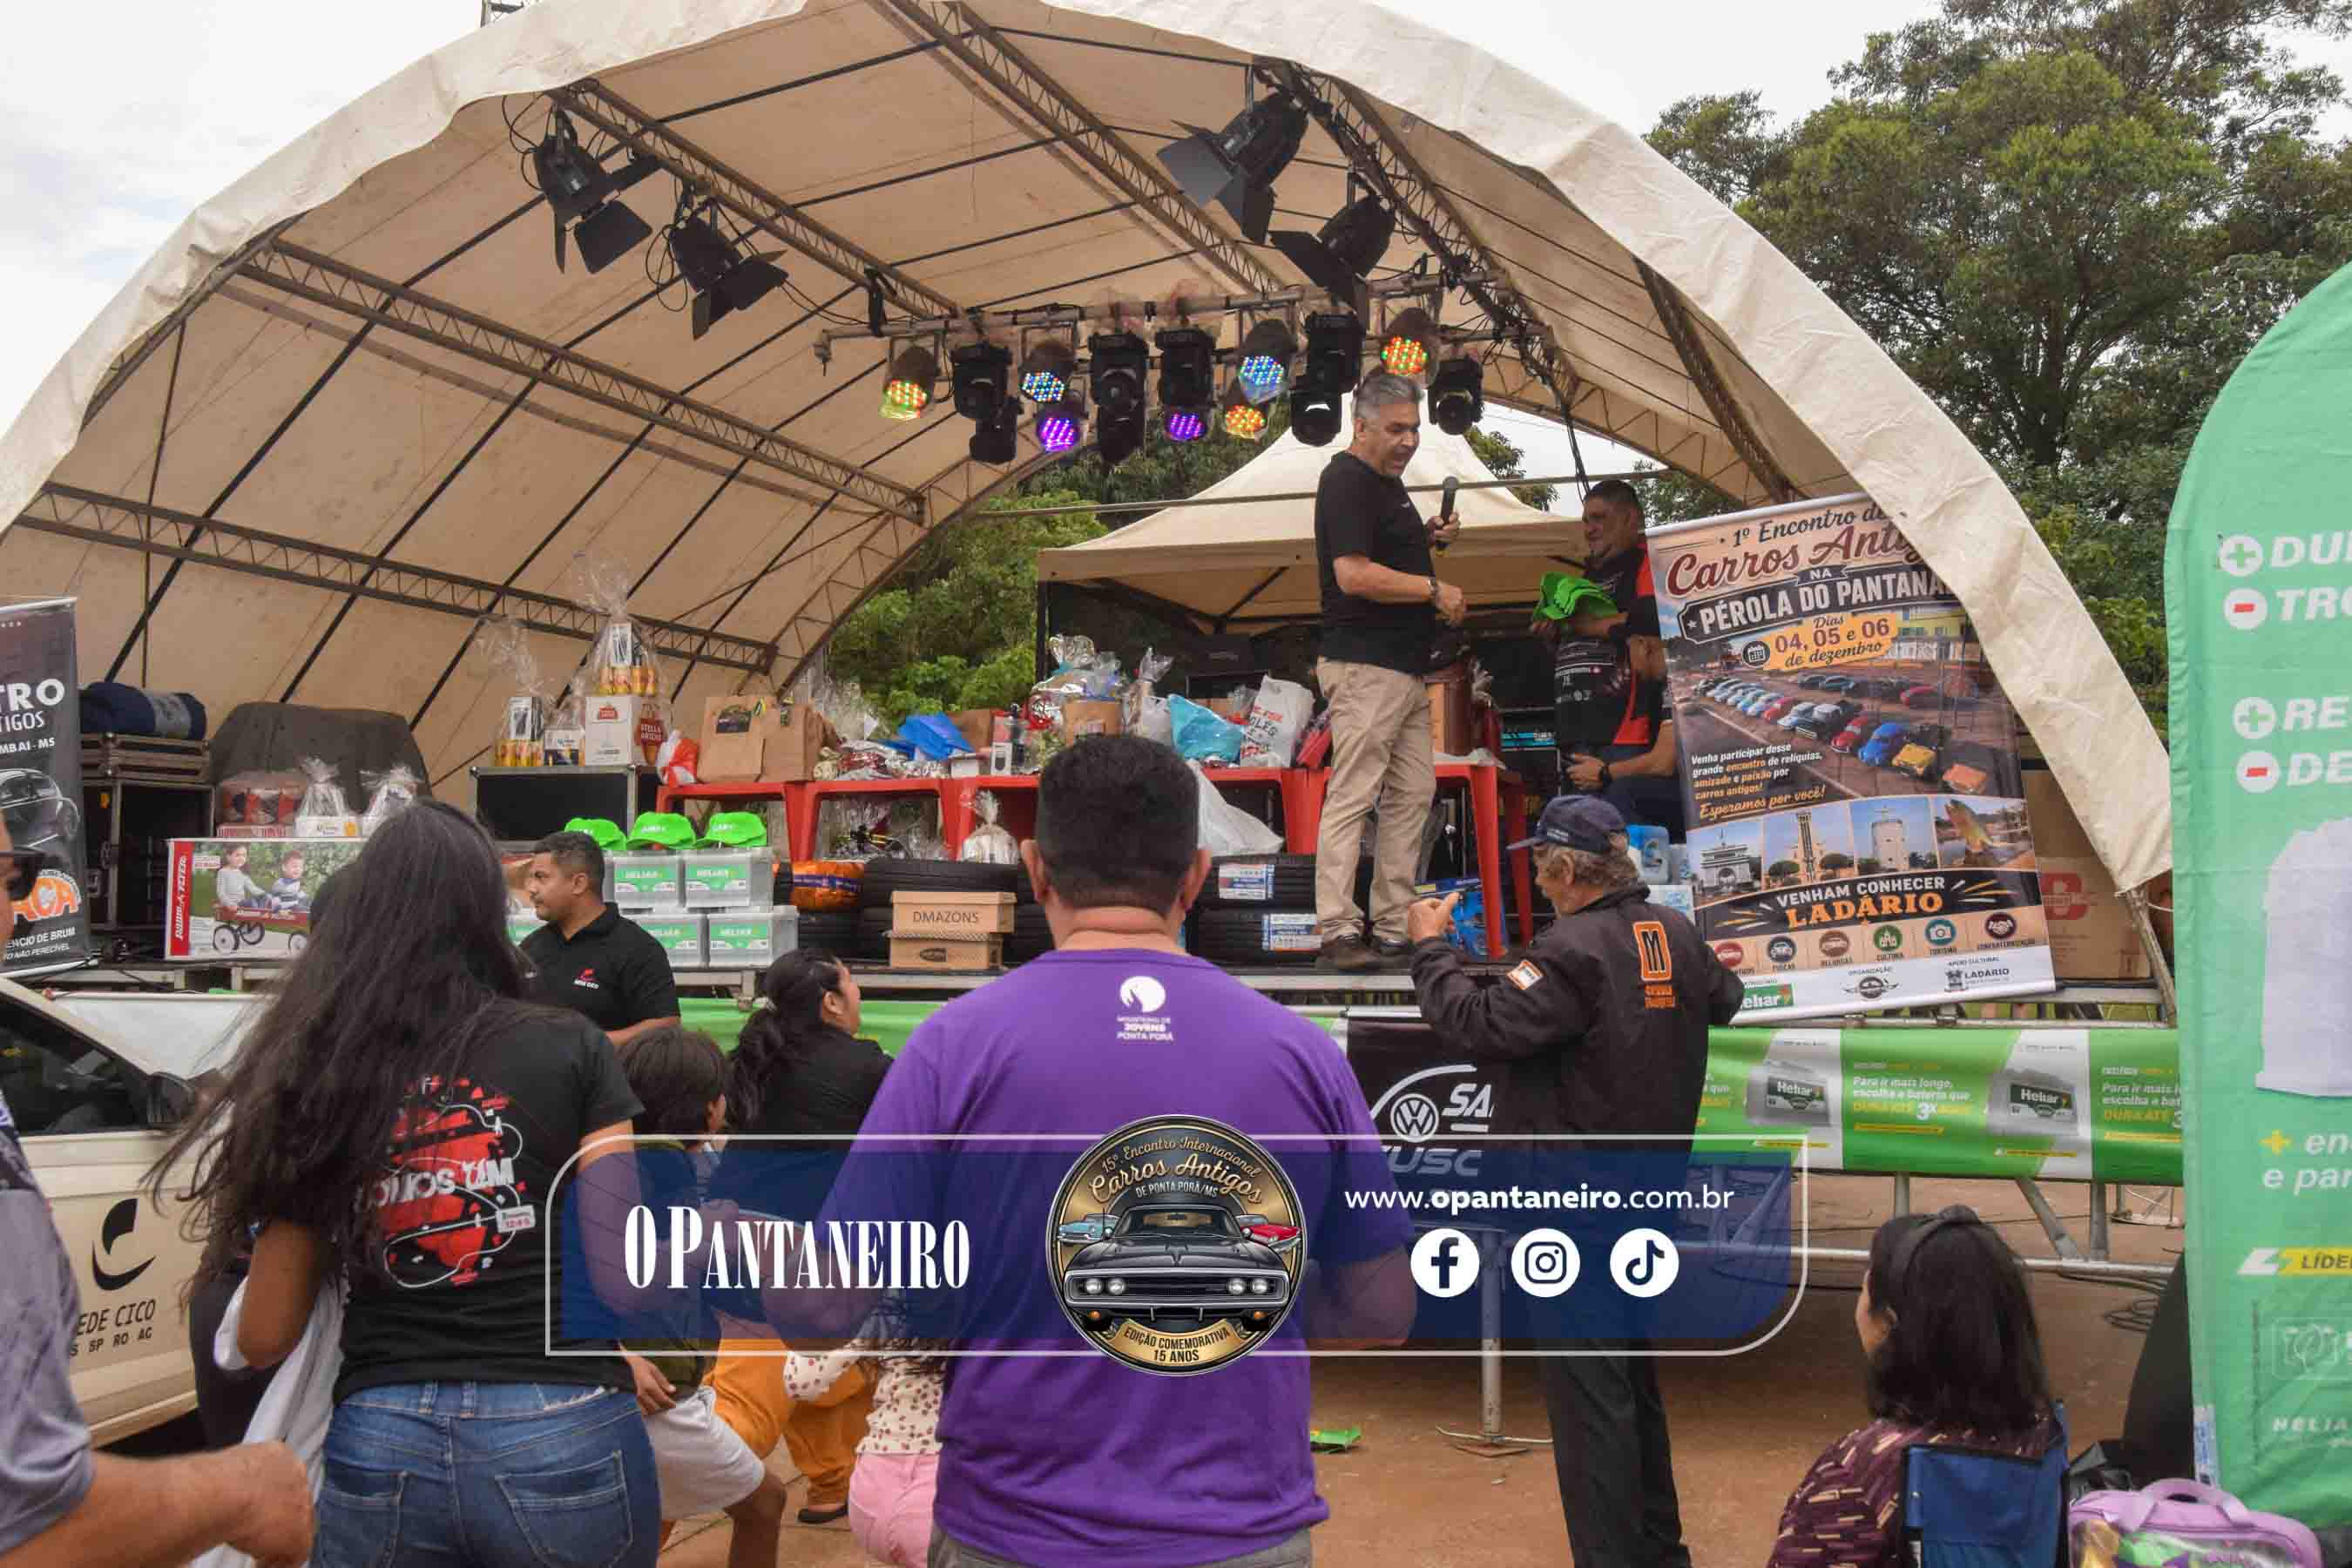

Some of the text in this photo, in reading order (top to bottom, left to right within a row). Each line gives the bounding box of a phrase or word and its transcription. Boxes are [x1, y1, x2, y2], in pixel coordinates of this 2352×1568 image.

[1758, 509, 1857, 544] Encontro
[2270, 531, 2352, 568] DU
[1666, 543, 1801, 596] Carros
[1809, 568, 1833, 582] NA
[1700, 571, 1950, 635] PÉROLA DO PANTANA
[1813, 614, 1844, 629] Dias
[1775, 618, 1889, 653] 04, 05 e 06
[1784, 640, 1882, 668] de dezembro
[0, 711, 44, 733] IGOS
[1692, 754, 1719, 765] Venha
[1720, 748, 1764, 764] participar
[1693, 765, 1724, 778] grande
[1726, 760, 1766, 773] encontro
[1767, 756, 1778, 767] de
[1773, 769, 1790, 781] por
[1694, 790, 1725, 800] carros
[1700, 799, 1767, 821] Esperamos
[1769, 794, 1792, 809] por
[1775, 876, 1945, 908] VENHAM CONHECER
[37, 932, 49, 943] DE
[50, 926, 76, 939] BRUM
[1743, 994, 1779, 1009] eliar
[1442, 1083, 1495, 1119] SA
[2305, 1133, 2352, 1155] en
[2263, 1167, 2284, 1187] e
[2300, 1251, 2352, 1269] LÍDE
[76, 1298, 156, 1336] EDE CICO
[89, 1337, 105, 1353] SP
[112, 1332, 130, 1348] RO
